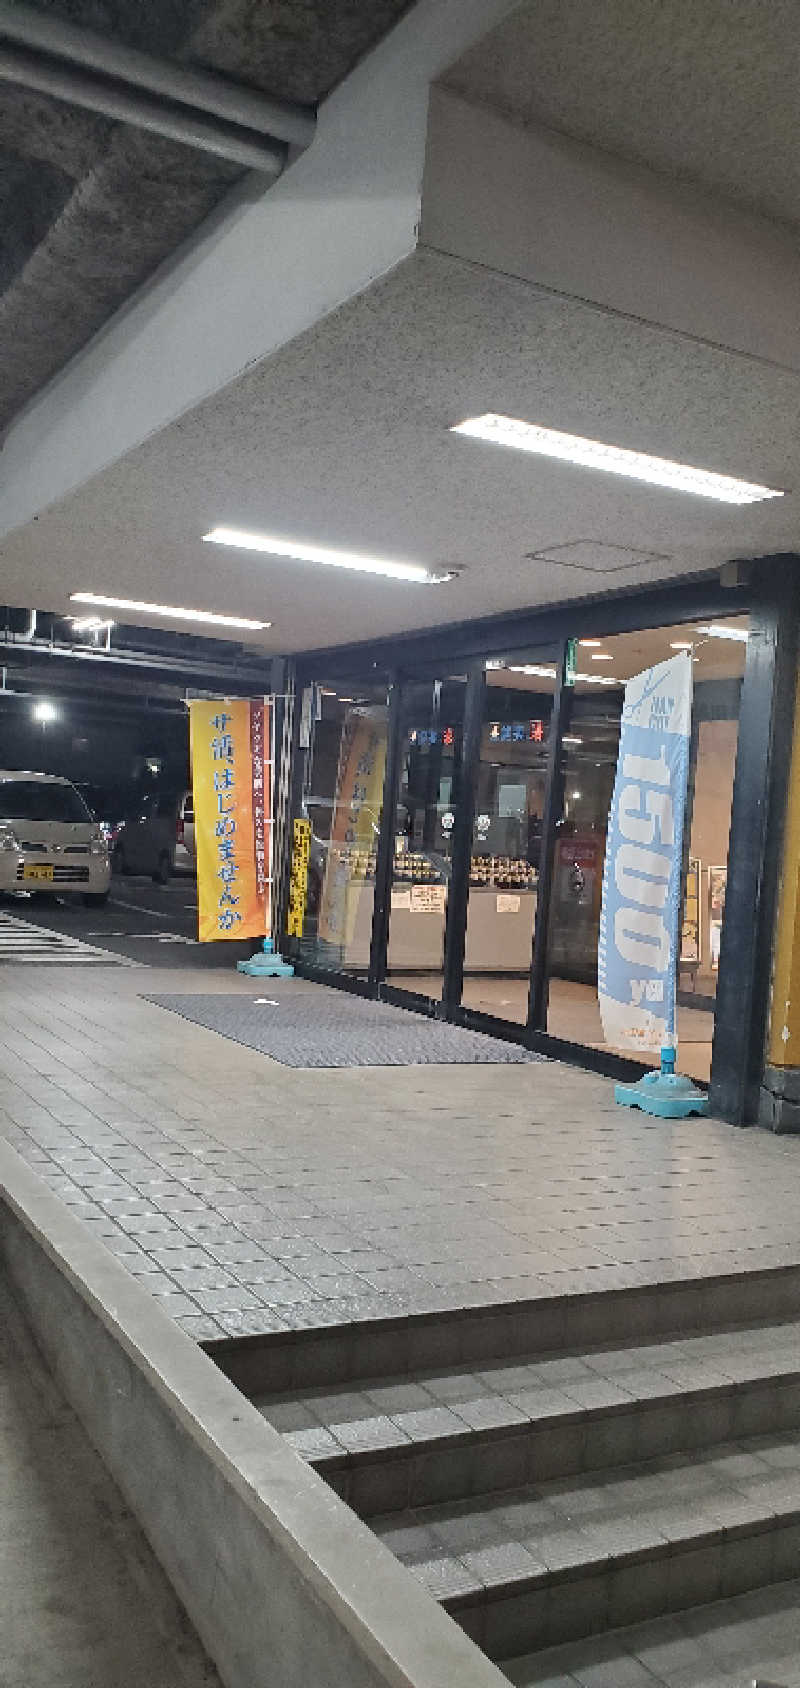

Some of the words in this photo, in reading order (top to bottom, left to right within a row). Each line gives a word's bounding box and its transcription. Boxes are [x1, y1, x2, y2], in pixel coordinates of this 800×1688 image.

[209, 712, 242, 930] サ活、はじめませんか
[614, 745, 674, 976] 1500
